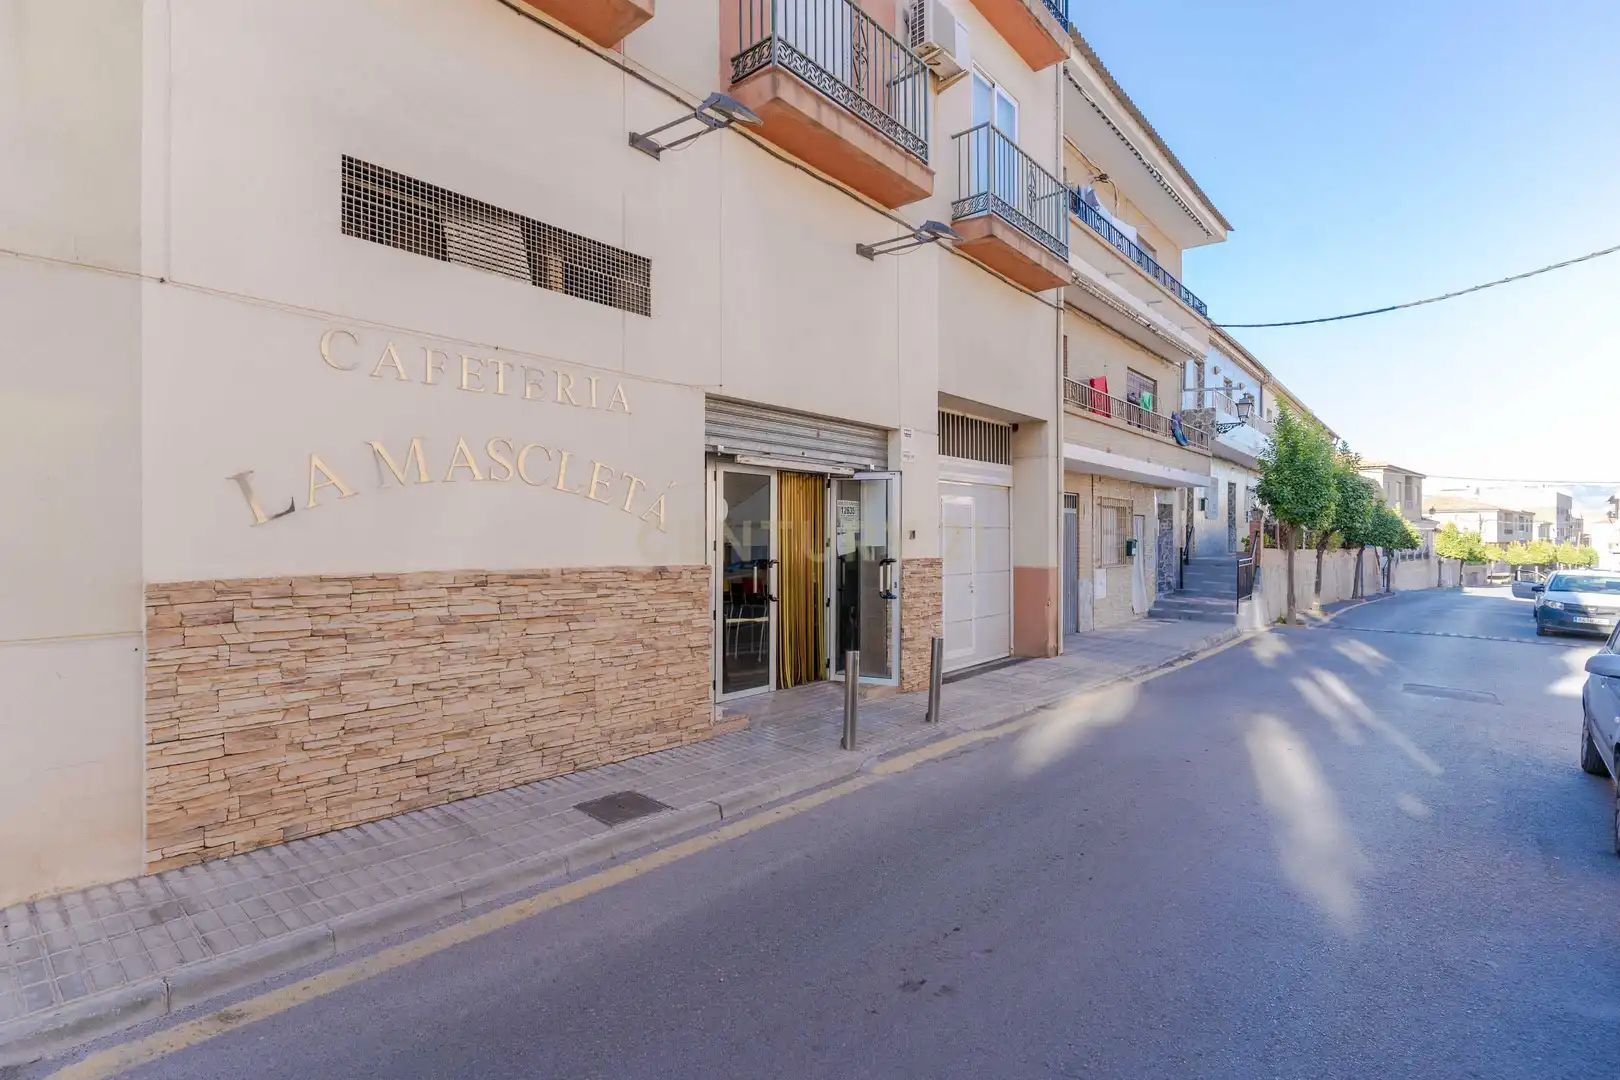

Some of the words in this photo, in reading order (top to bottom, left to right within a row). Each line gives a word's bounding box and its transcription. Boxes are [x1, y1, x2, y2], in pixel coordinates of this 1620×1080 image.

[319, 328, 632, 415] CAFETERIA
[225, 451, 359, 527] LA
[364, 436, 676, 533] MASCLETÁ
